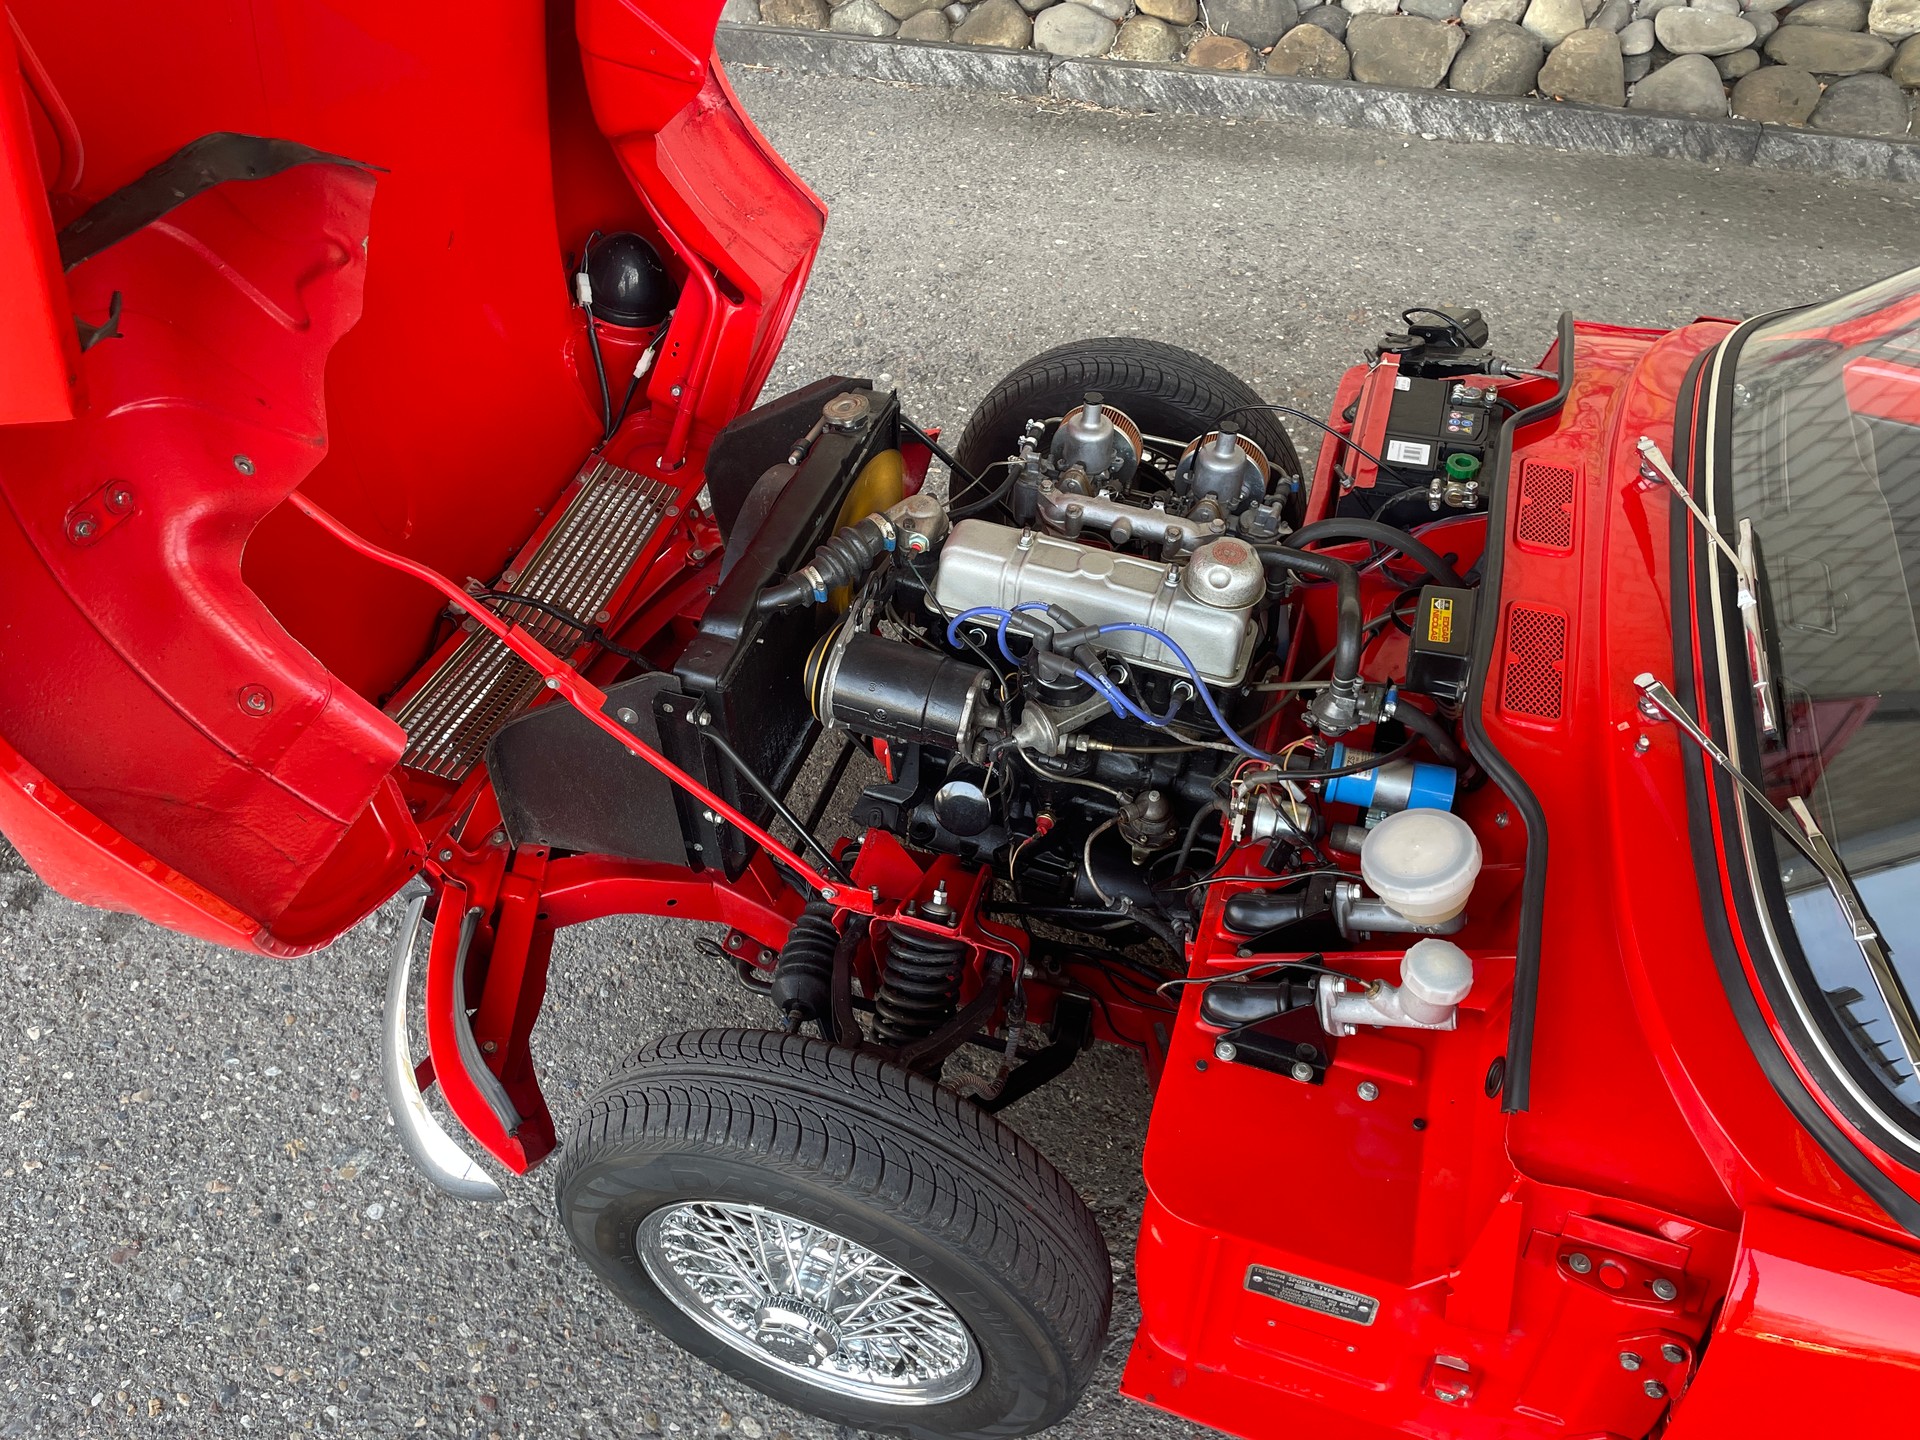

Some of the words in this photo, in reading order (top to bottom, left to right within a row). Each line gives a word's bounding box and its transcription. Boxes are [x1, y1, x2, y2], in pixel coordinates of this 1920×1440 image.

[1431, 608, 1440, 641] NICOLAS
[1442, 616, 1450, 642] EDGAR
[1254, 1267, 1286, 1280] TRIUMPH
[1319, 1285, 1337, 1294] TYPE
[1342, 1292, 1373, 1305] SPITFIRE
